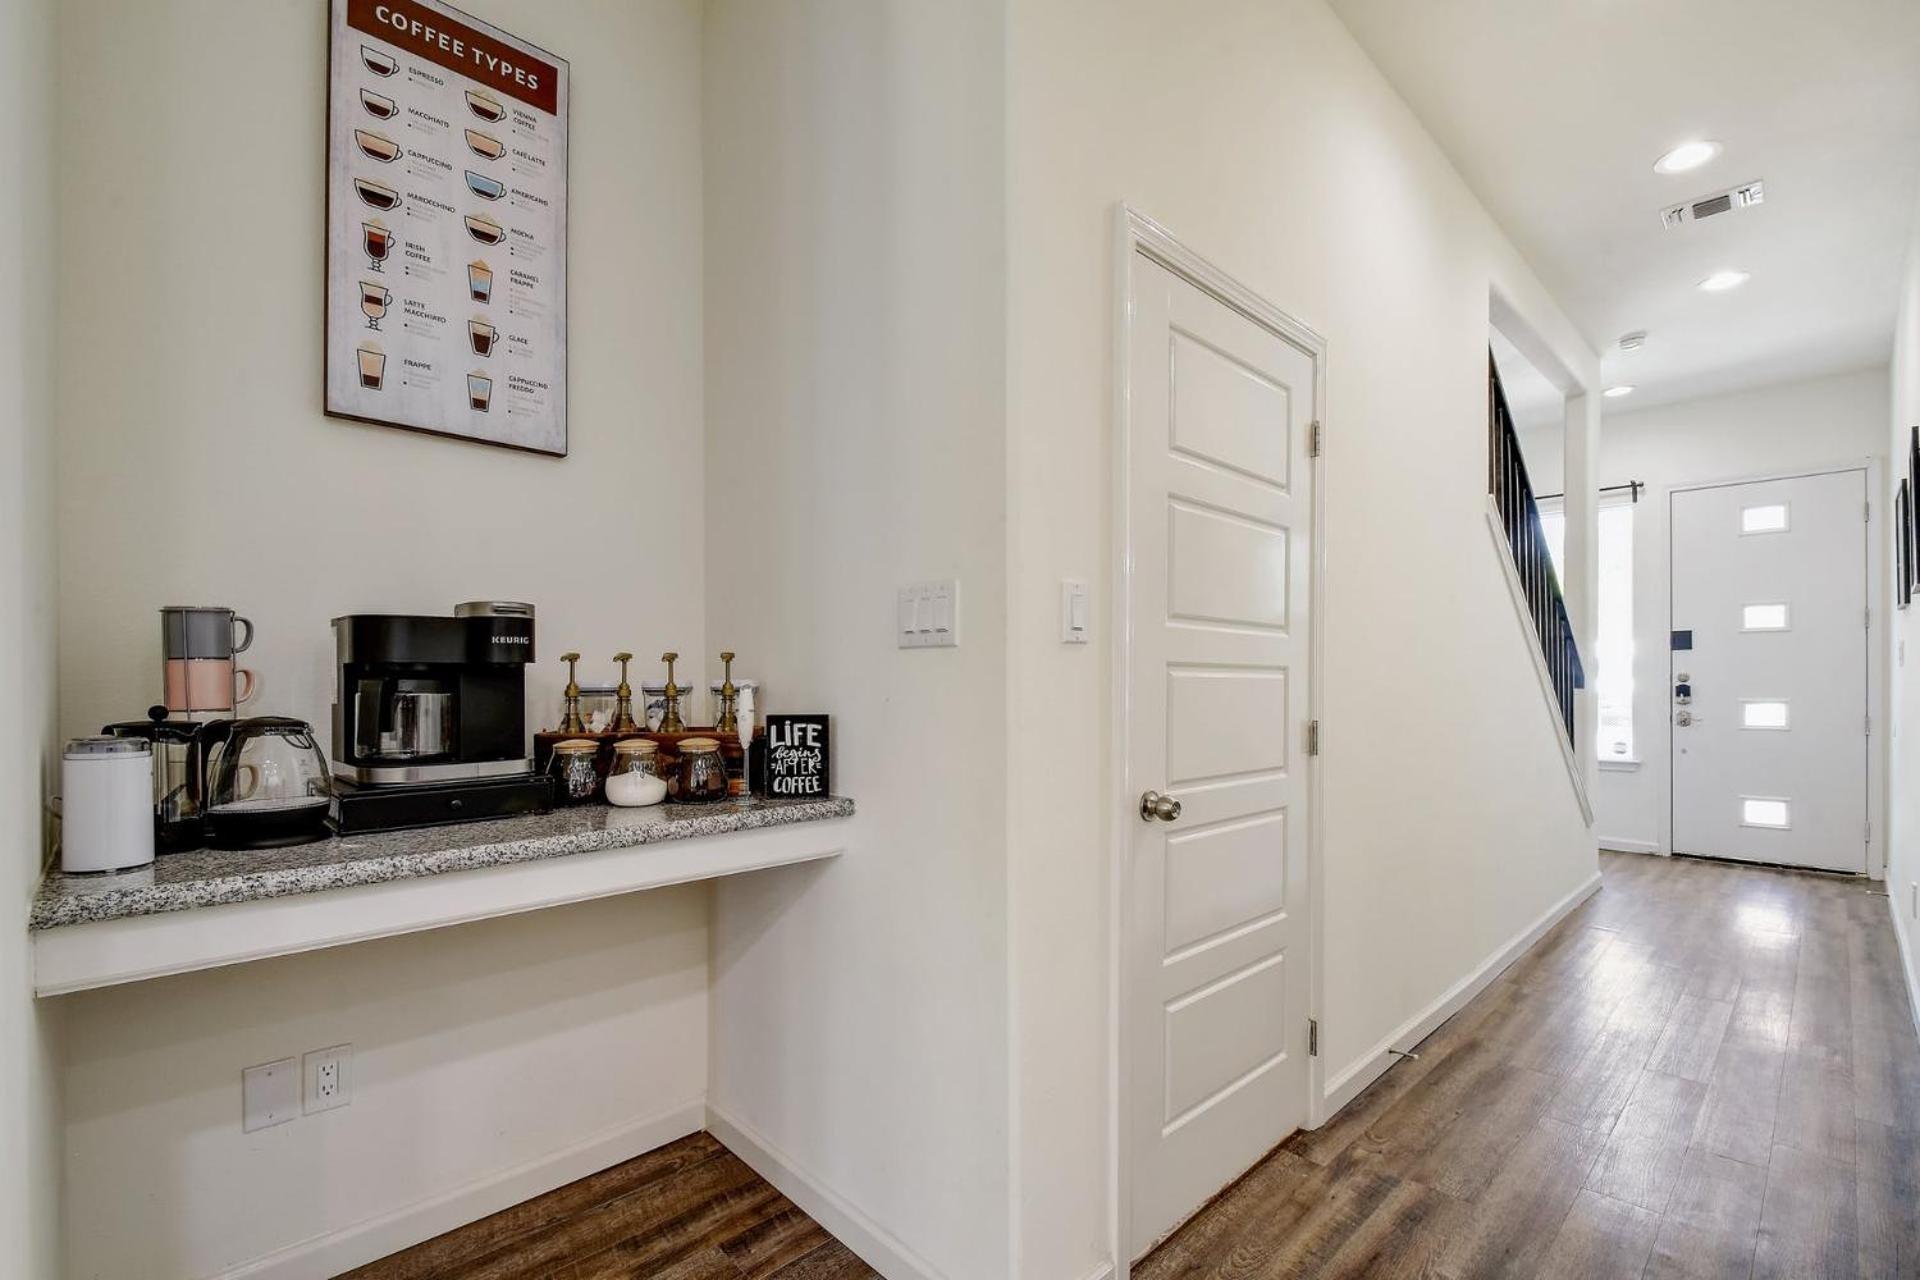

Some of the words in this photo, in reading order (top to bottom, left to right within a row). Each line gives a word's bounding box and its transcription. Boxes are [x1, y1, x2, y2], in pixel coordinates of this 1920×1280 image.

[375, 5, 465, 57] COFFEE
[472, 47, 539, 91] TYPES
[408, 66, 444, 86] ESPRESSO
[408, 107, 450, 129] MACCHIATO
[512, 109, 537, 124] VIENNA
[513, 116, 536, 131] COFFEE
[407, 149, 453, 171] CAPPUCCINO
[528, 155, 546, 167] LATTE
[511, 188, 549, 206] AMERICANO
[511, 228, 535, 241] MOCHA
[405, 241, 426, 252] IRISH
[405, 250, 431, 263] COFFEE
[510, 269, 540, 284] CARAMEL
[510, 277, 534, 290] FRAPPE
[404, 299, 425, 310] LATTE
[404, 307, 447, 324] MACCHIATO
[509, 335, 528, 345] GLACE
[403, 358, 432, 371] FRAPPE
[508, 375, 549, 390] CAPPUCCINO
[508, 383, 535, 394] FREDDO
[491, 636, 530, 645] KEURIG
[771, 745, 822, 763] begins
[774, 758, 818, 775] AFTER
[773, 775, 823, 795] COFFEE
